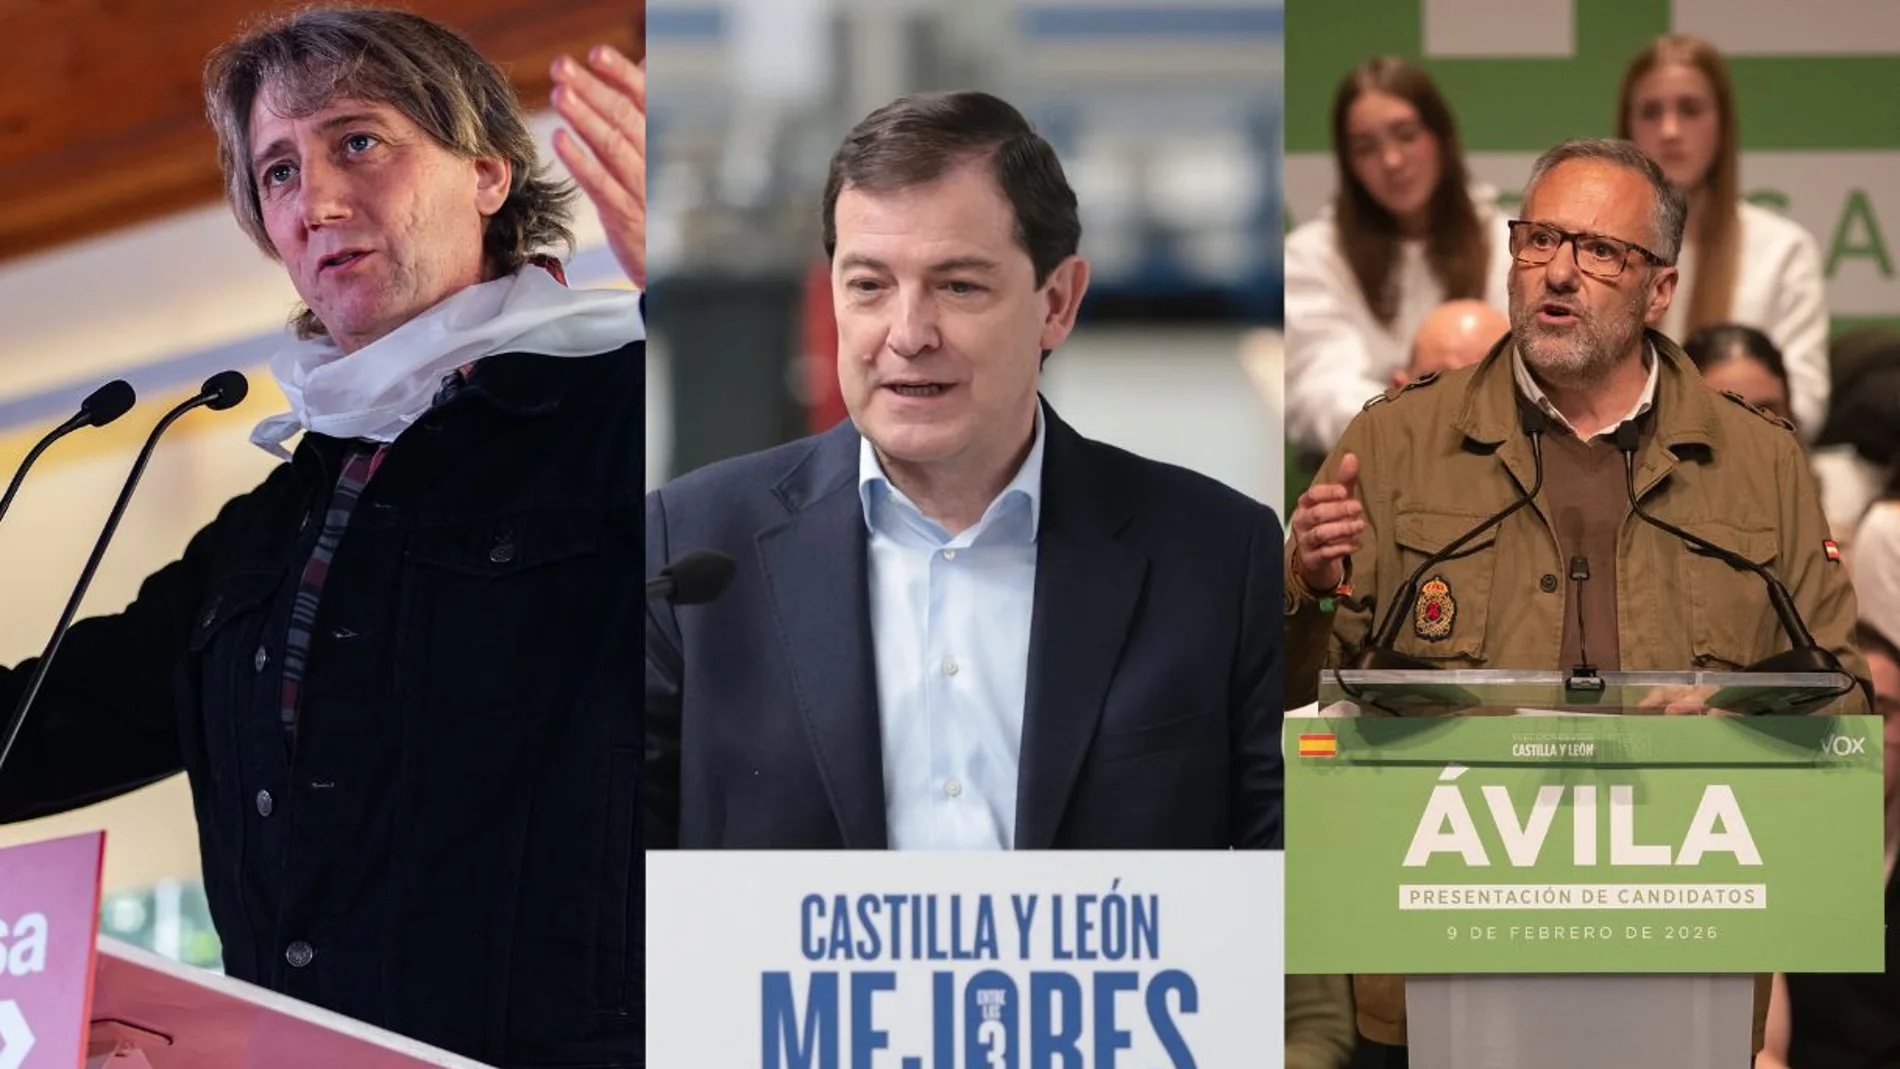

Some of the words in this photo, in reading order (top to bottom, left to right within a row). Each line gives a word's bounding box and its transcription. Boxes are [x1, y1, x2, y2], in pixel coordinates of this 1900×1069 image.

[1512, 743, 1557, 757] CASTILLA
[1559, 743, 1567, 757] Y
[1568, 741, 1594, 757] LEÓN
[1821, 734, 1865, 756] VOX
[1402, 766, 1763, 867] ÁVILA
[1409, 886, 1572, 905] PRESENTACIÓN
[1582, 889, 1608, 905] DE
[1617, 888, 1756, 905] CANDIDATOS
[801, 893, 999, 961] CASTILLA
[1011, 893, 1038, 961] Y
[1052, 877, 1159, 961] LEÓN
[1446, 926, 1458, 940] 9
[1470, 926, 1497, 940] DE
[1509, 926, 1613, 940] FEBRERO
[1625, 926, 1653, 940] DE
[1664, 926, 1718, 940] 2026
[761, 969, 1199, 1069] MEJORES
